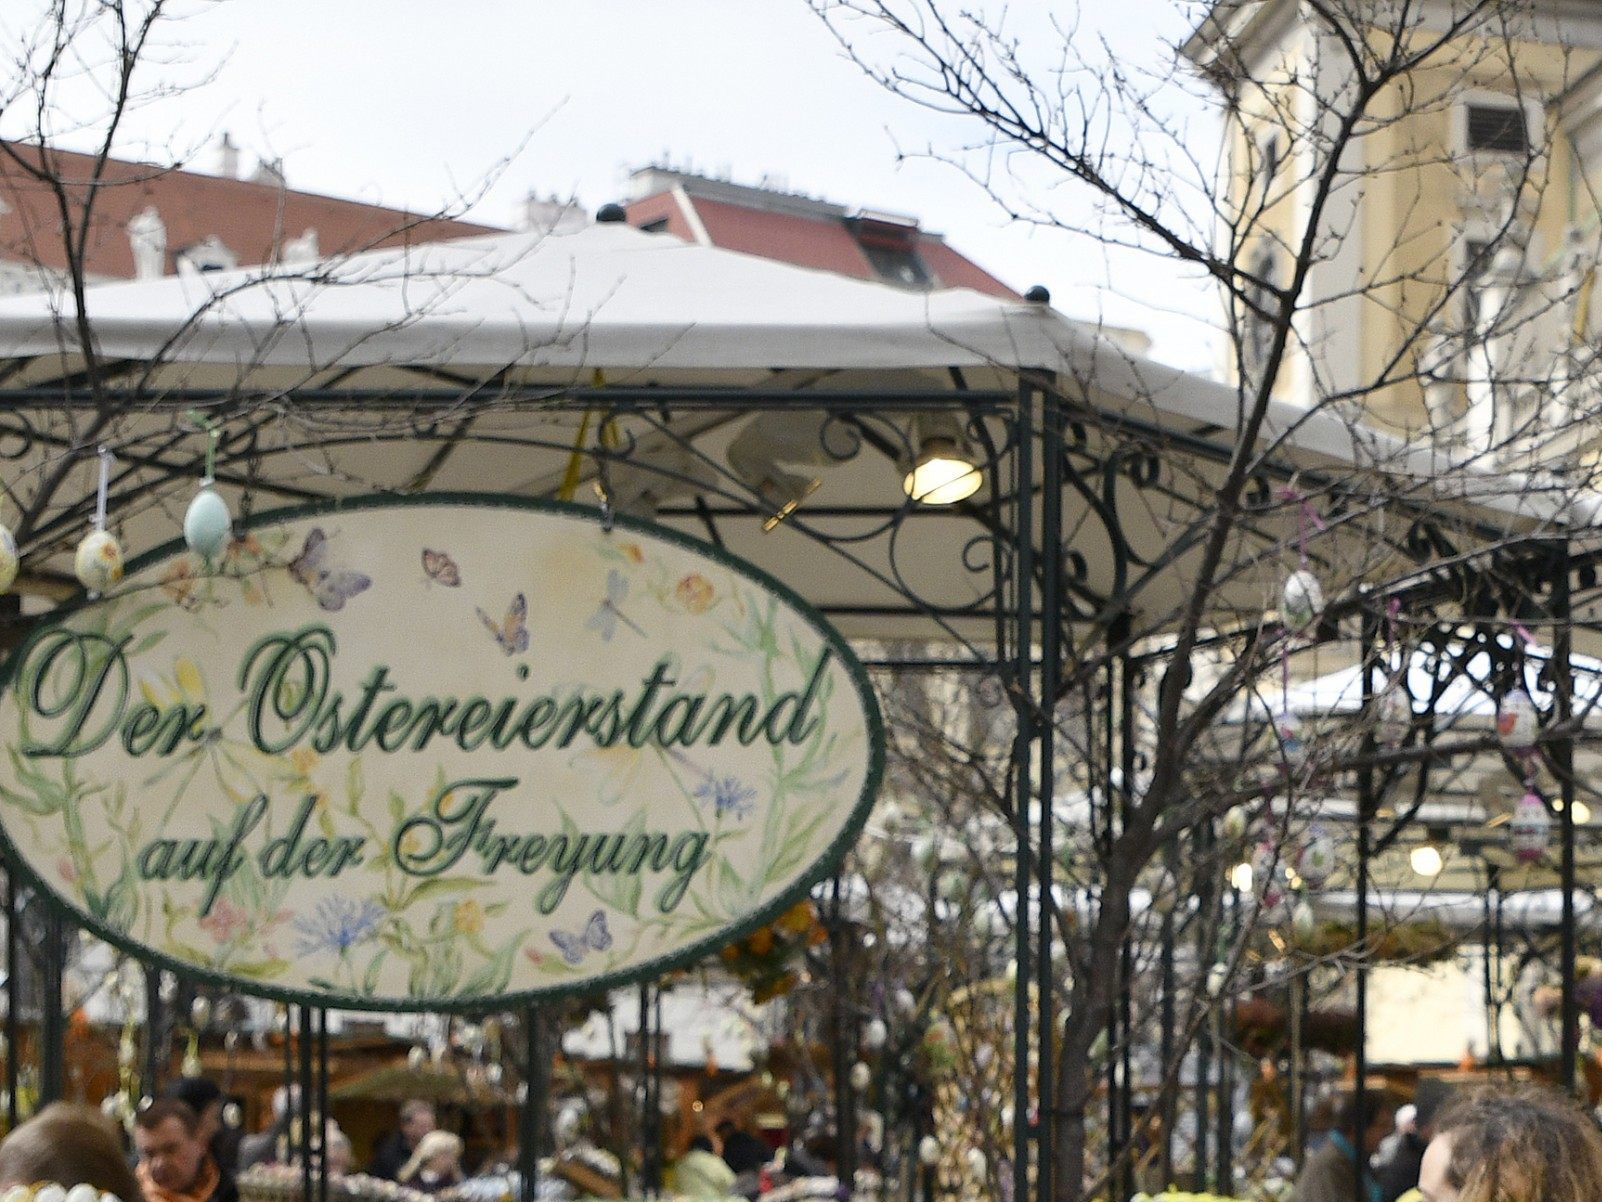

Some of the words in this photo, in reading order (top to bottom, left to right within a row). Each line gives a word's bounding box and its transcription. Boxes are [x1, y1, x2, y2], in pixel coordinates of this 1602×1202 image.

[17, 630, 205, 757] Der
[239, 628, 834, 755] Ostereierstand
[139, 795, 267, 916] auf
[262, 795, 366, 880] der
[396, 778, 711, 914] Freyung
